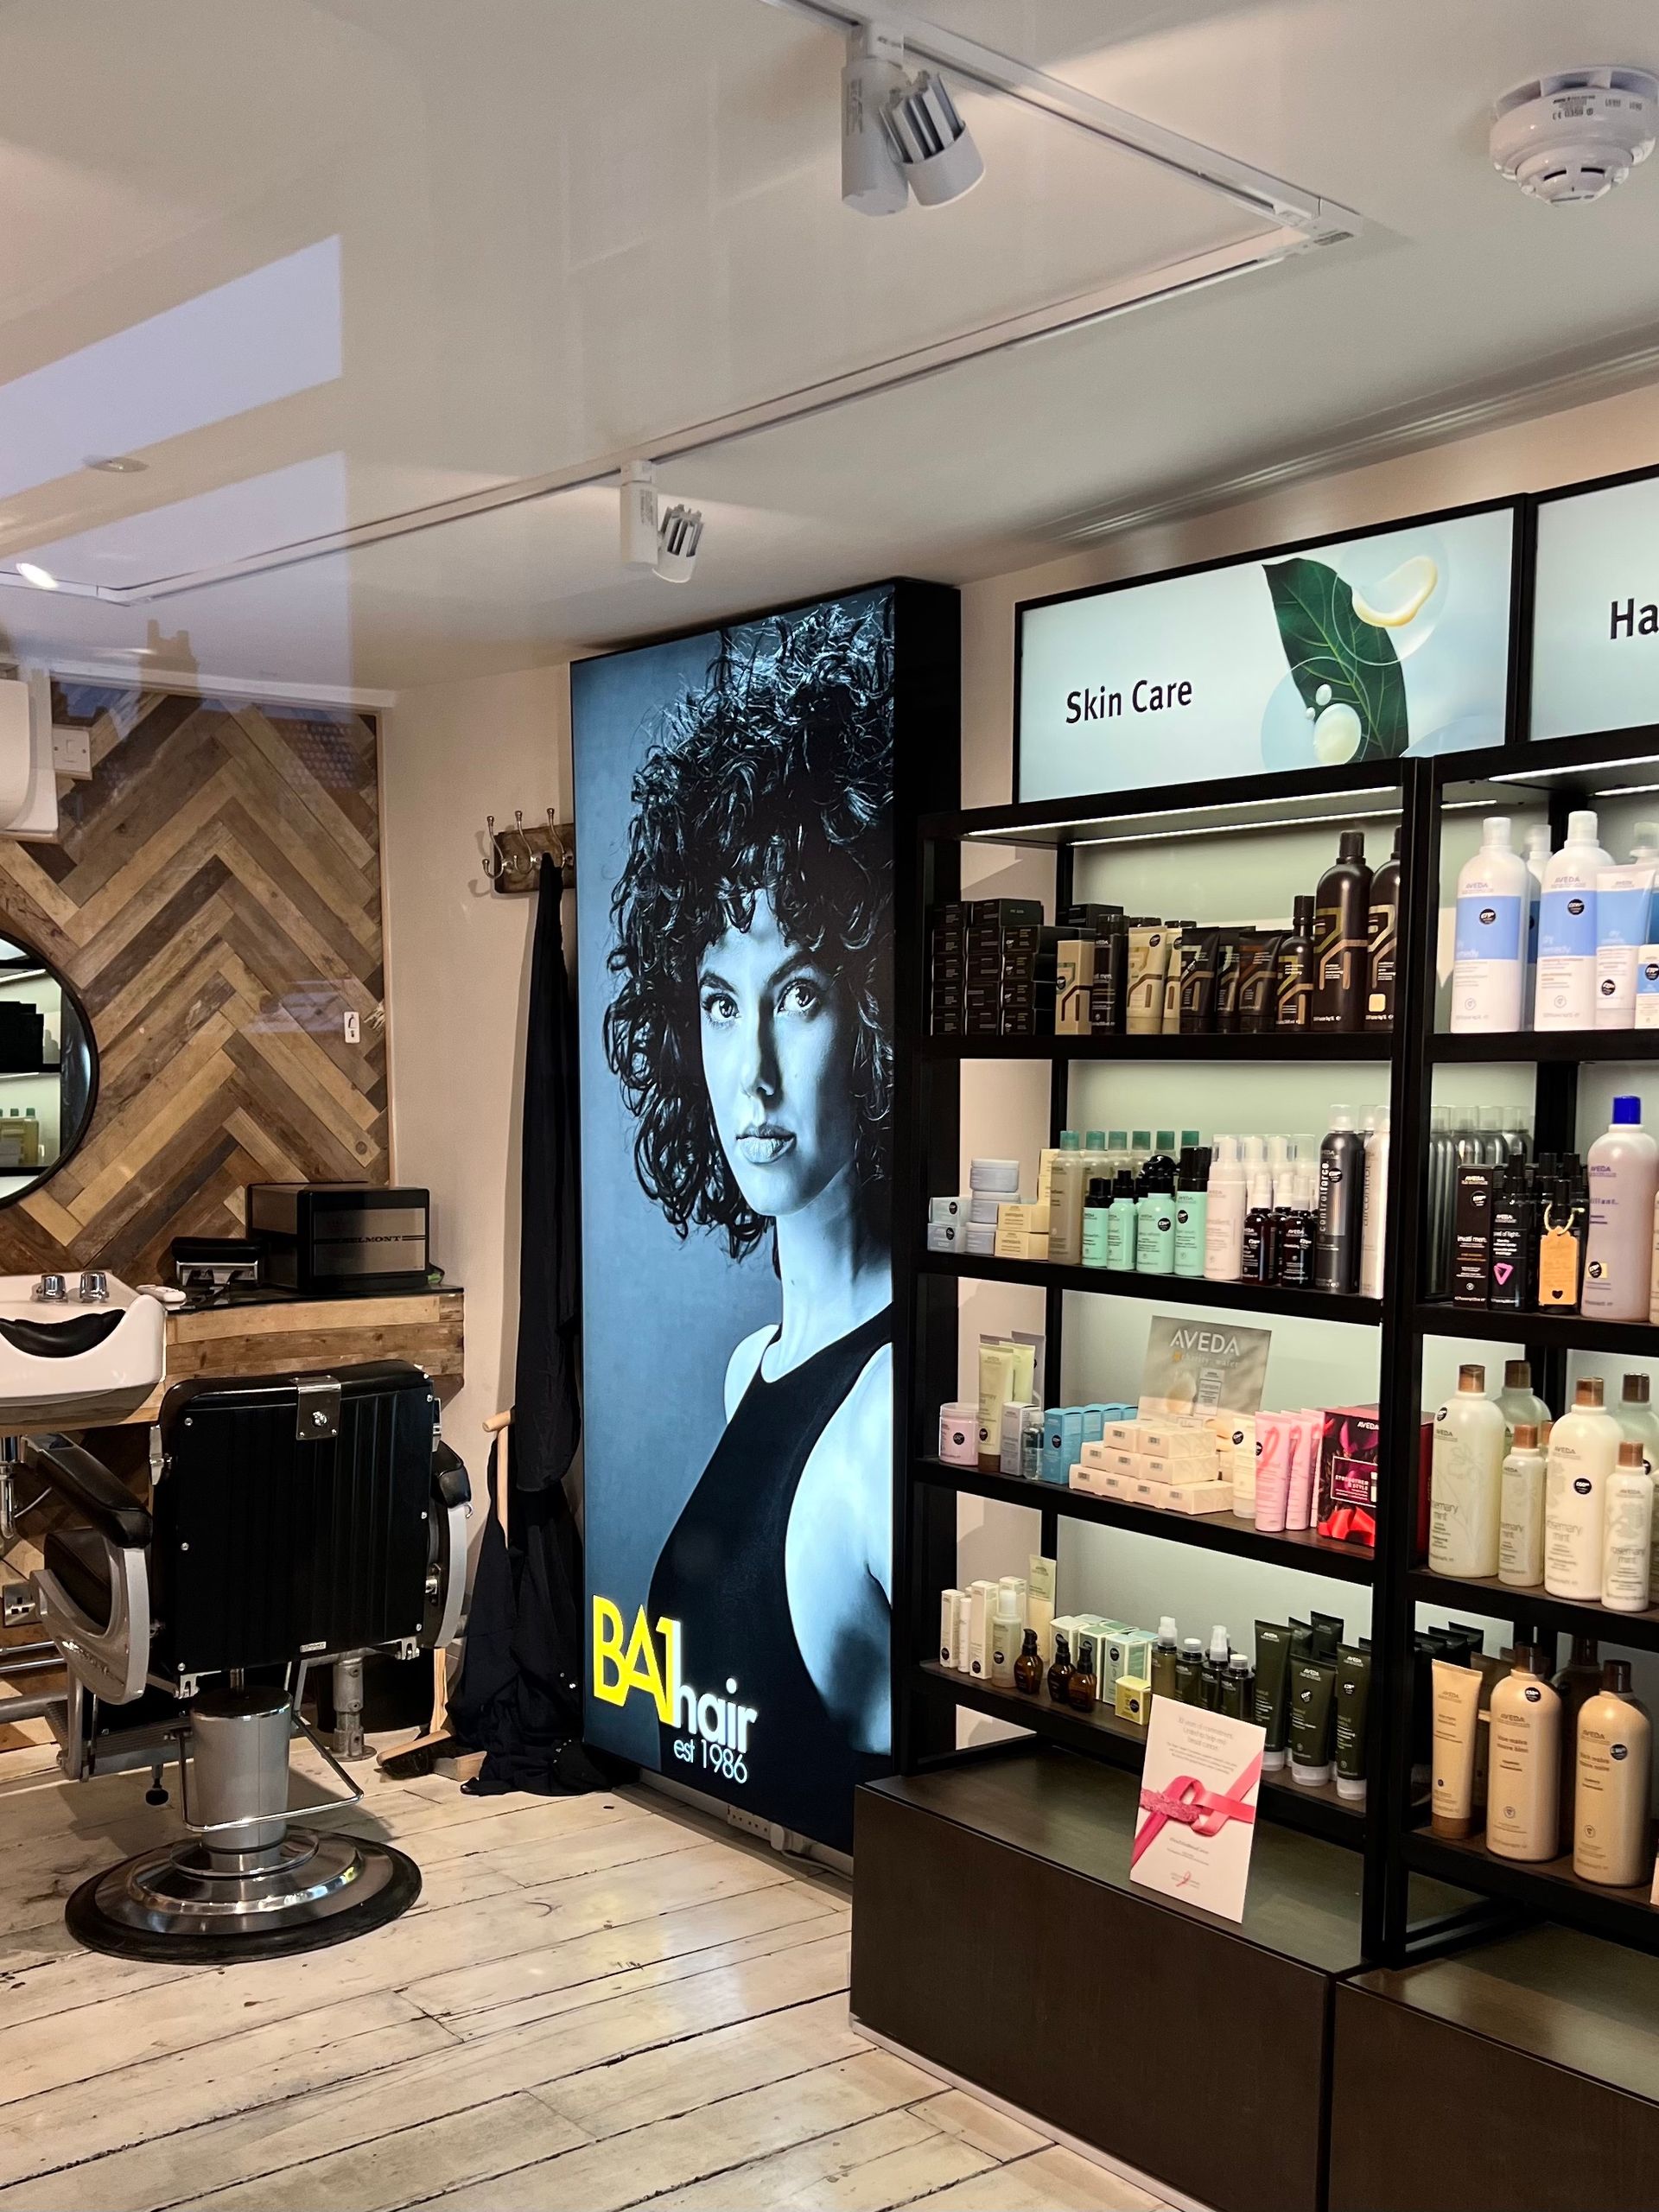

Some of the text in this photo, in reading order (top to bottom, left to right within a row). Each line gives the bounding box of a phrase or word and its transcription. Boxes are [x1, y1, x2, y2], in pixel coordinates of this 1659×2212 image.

[1065, 676, 1192, 724] Skin Care
[1170, 1328, 1240, 1357] AVEDA
[1357, 1421, 1379, 1430] AVEDA
[672, 1621, 759, 1753] hair
[674, 1738, 748, 1784] est 1986
